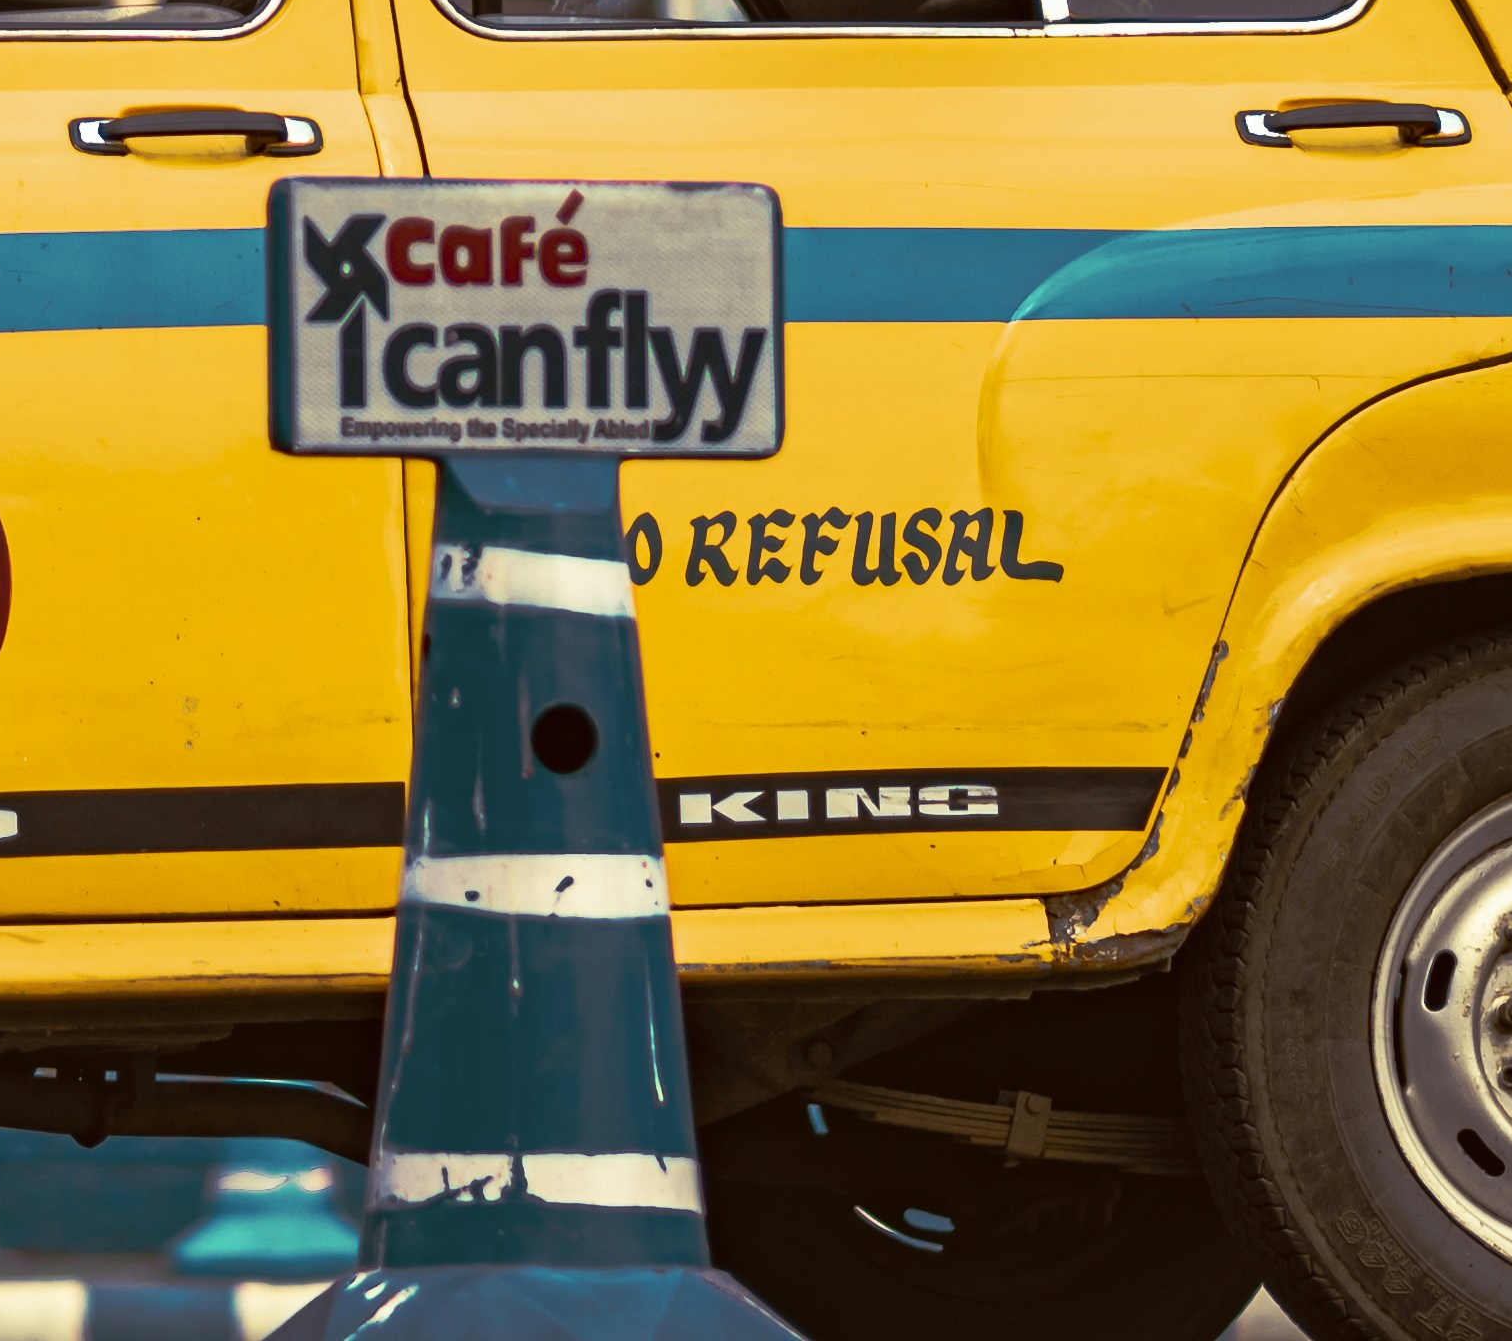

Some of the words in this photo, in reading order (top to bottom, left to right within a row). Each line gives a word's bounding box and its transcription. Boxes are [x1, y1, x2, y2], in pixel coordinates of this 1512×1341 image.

[385, 188, 590, 288] Café
[340, 416, 463, 443] Empowering
[466, 418, 498, 439] the
[501, 417, 591, 444] Specially
[592, 419, 651, 440] Abled
[685, 505, 1065, 587] REFUSAL
[679, 785, 999, 825] KING
